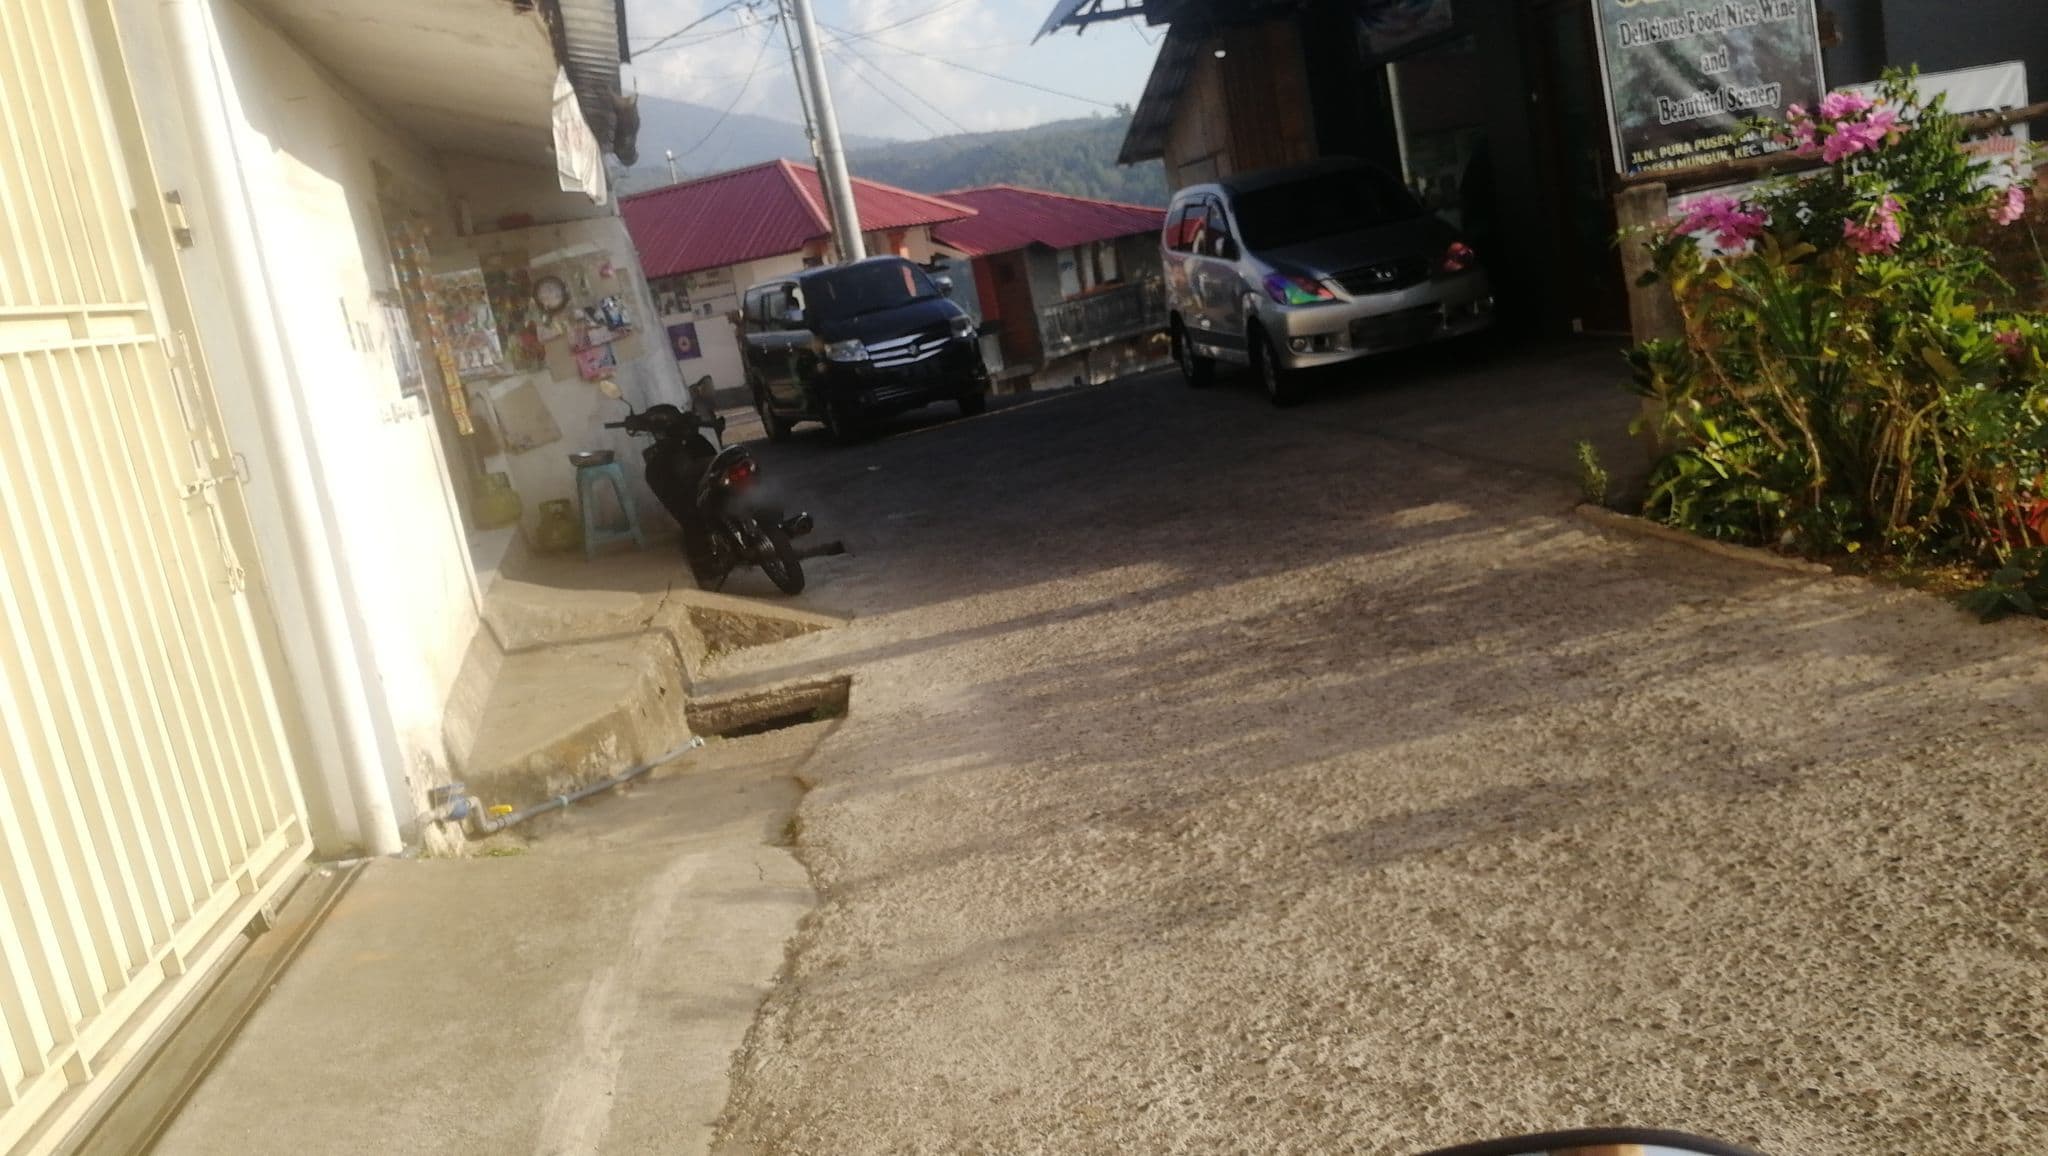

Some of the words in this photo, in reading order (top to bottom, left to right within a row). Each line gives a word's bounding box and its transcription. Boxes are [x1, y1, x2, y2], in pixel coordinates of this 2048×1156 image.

[1619, 17, 1685, 46] Delicious
[1725, 4, 1758, 27] Nice
[1759, 0, 1796, 19] Wine
[1703, 50, 1728, 72] and
[1659, 87, 1725, 121] Beautiful
[1726, 85, 1779, 109] Scenery
[1659, 142, 1694, 158] PURA
